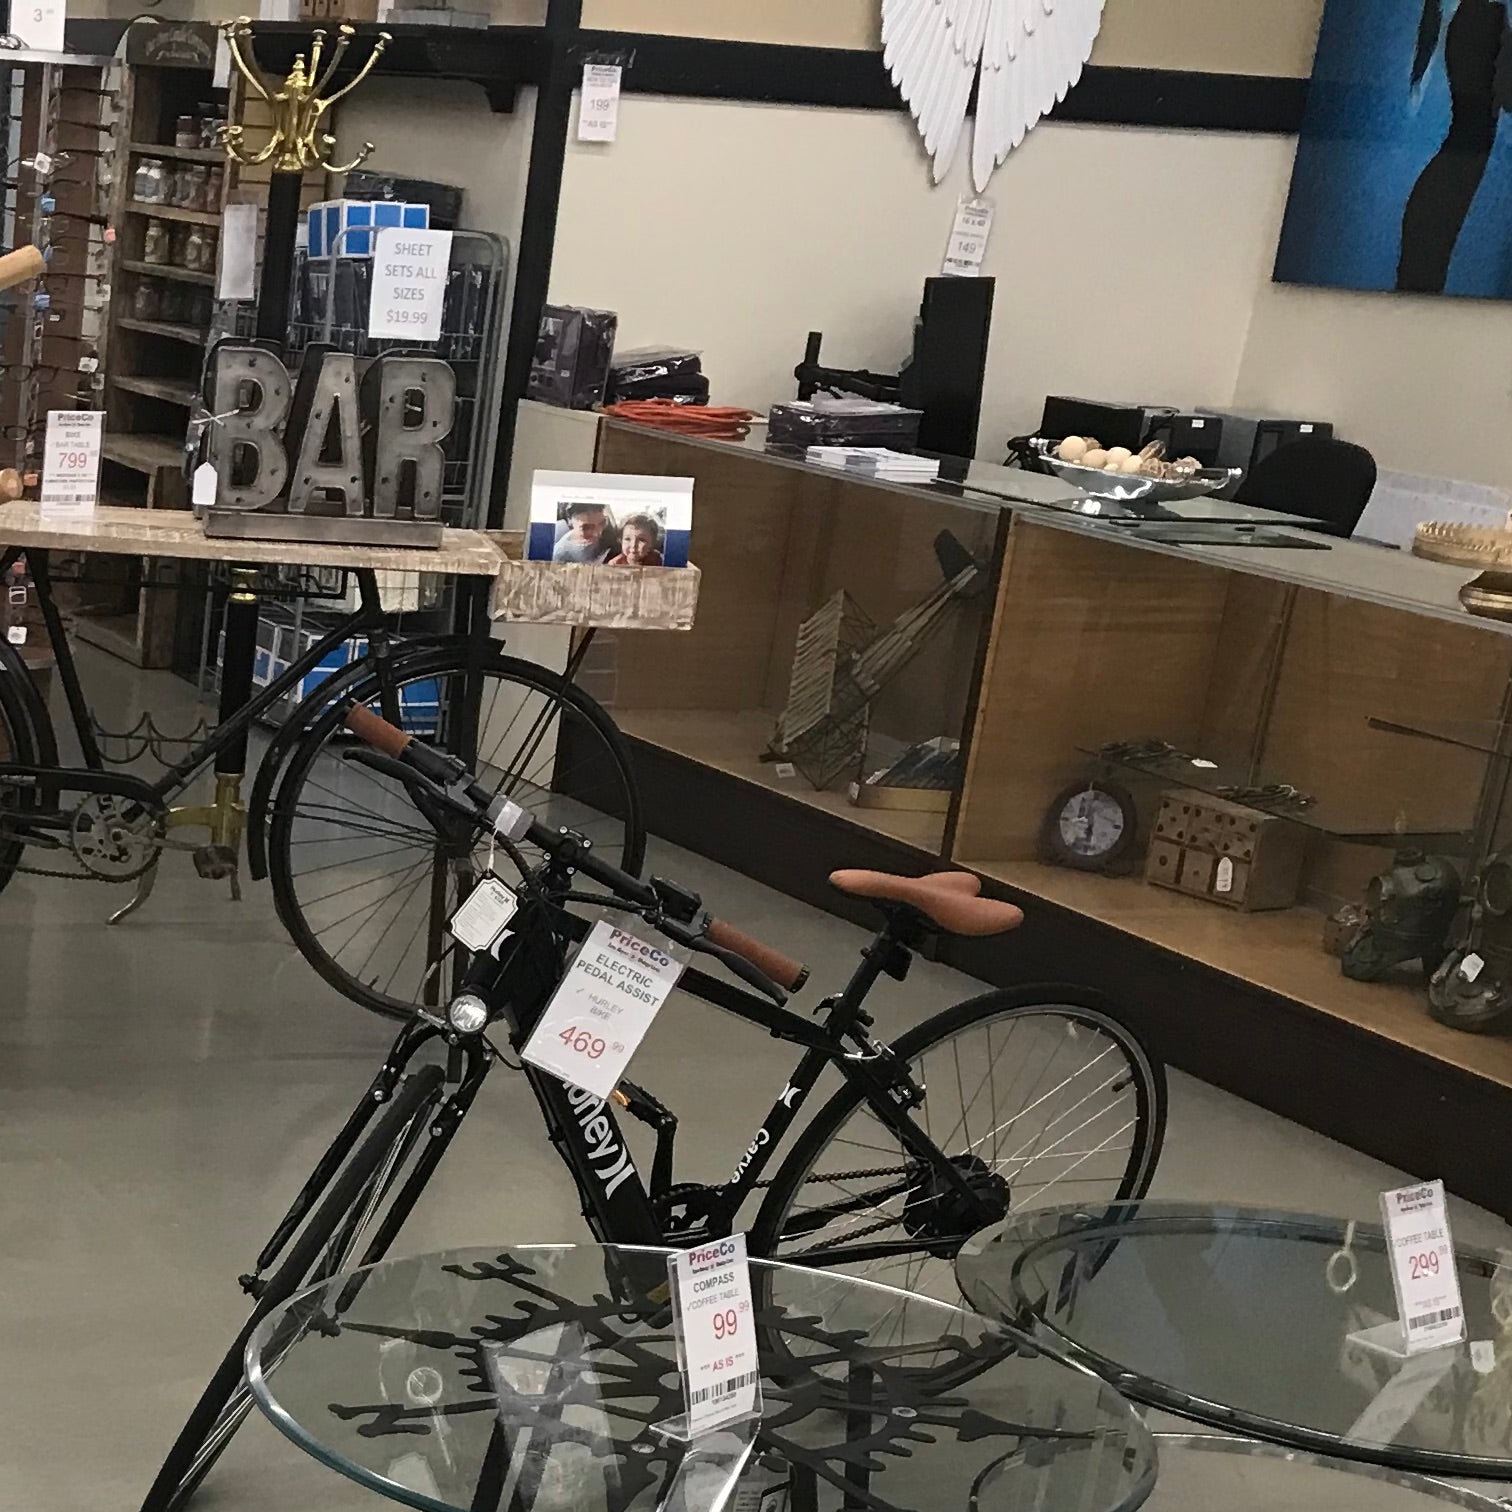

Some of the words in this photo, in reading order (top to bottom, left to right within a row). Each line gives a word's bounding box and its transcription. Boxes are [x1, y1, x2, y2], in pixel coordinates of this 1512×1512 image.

[394, 242, 433, 256] SHEET
[385, 264, 413, 278] SETS
[415, 266, 437, 279] ALL
[392, 287, 425, 301] SIZES
[386, 308, 428, 324] $19.99
[57, 413, 94, 422] PriceCo
[204, 345, 456, 518] BAR
[58, 452, 88, 469] 799
[610, 928, 669, 968] PriceCo
[596, 953, 653, 989] ELECTRIC
[576, 959, 614, 986] PEDAL
[615, 980, 660, 1007] ASSIST
[588, 993, 624, 1016] HURLEY
[589, 1006, 612, 1021] BIKE
[559, 1026, 607, 1060] 469
[731, 1127, 770, 1184] Carve
[1397, 1187, 1434, 1205] PriceCo
[1395, 1231, 1423, 1248] COFFEE
[1423, 1227, 1444, 1242] TABLE
[689, 1242, 736, 1266] PriceCo
[1408, 1250, 1440, 1281] 299
[693, 1271, 735, 1293] COMPASS
[691, 1294, 718, 1311] COFFEE
[719, 1287, 739, 1304] TABLE
[713, 1308, 738, 1340] 99
[712, 1357, 724, 1372] AS
[725, 1355, 734, 1368] IS
